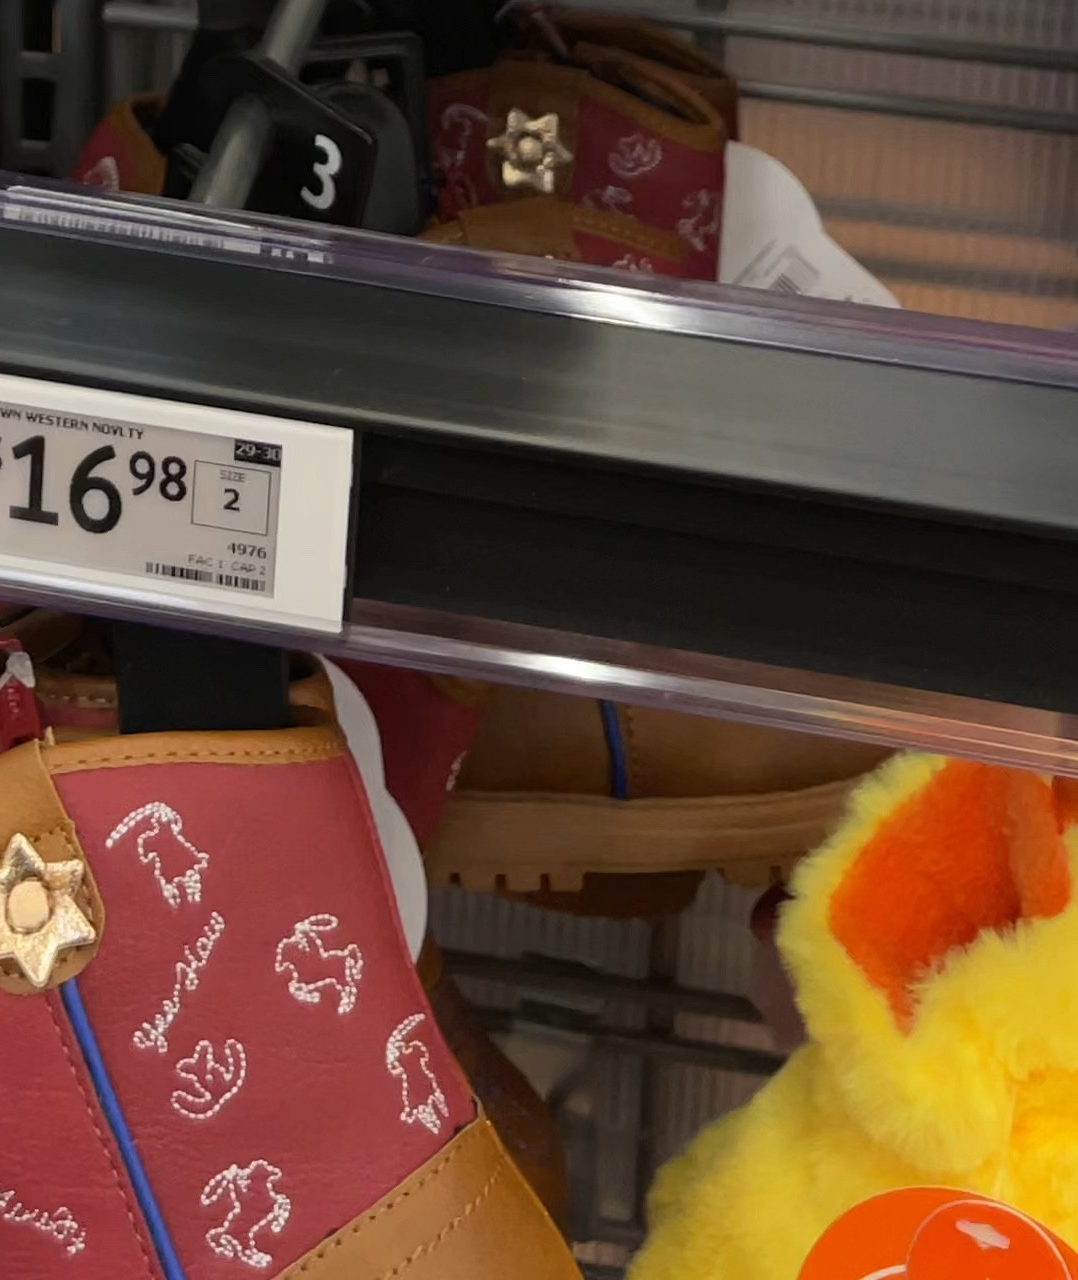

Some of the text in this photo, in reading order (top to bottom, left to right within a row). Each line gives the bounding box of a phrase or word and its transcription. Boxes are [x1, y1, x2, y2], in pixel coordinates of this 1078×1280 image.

[300, 133, 342, 210] 3
[0, 407, 22, 421] WN
[25, 411, 90, 432] WESTERN
[92, 421, 145, 441] NOVLTY
[235, 442, 282, 462] 29-30
[219, 469, 246, 484] SIZE
[223, 488, 240, 512] 2
[226, 541, 268, 560] 4976
